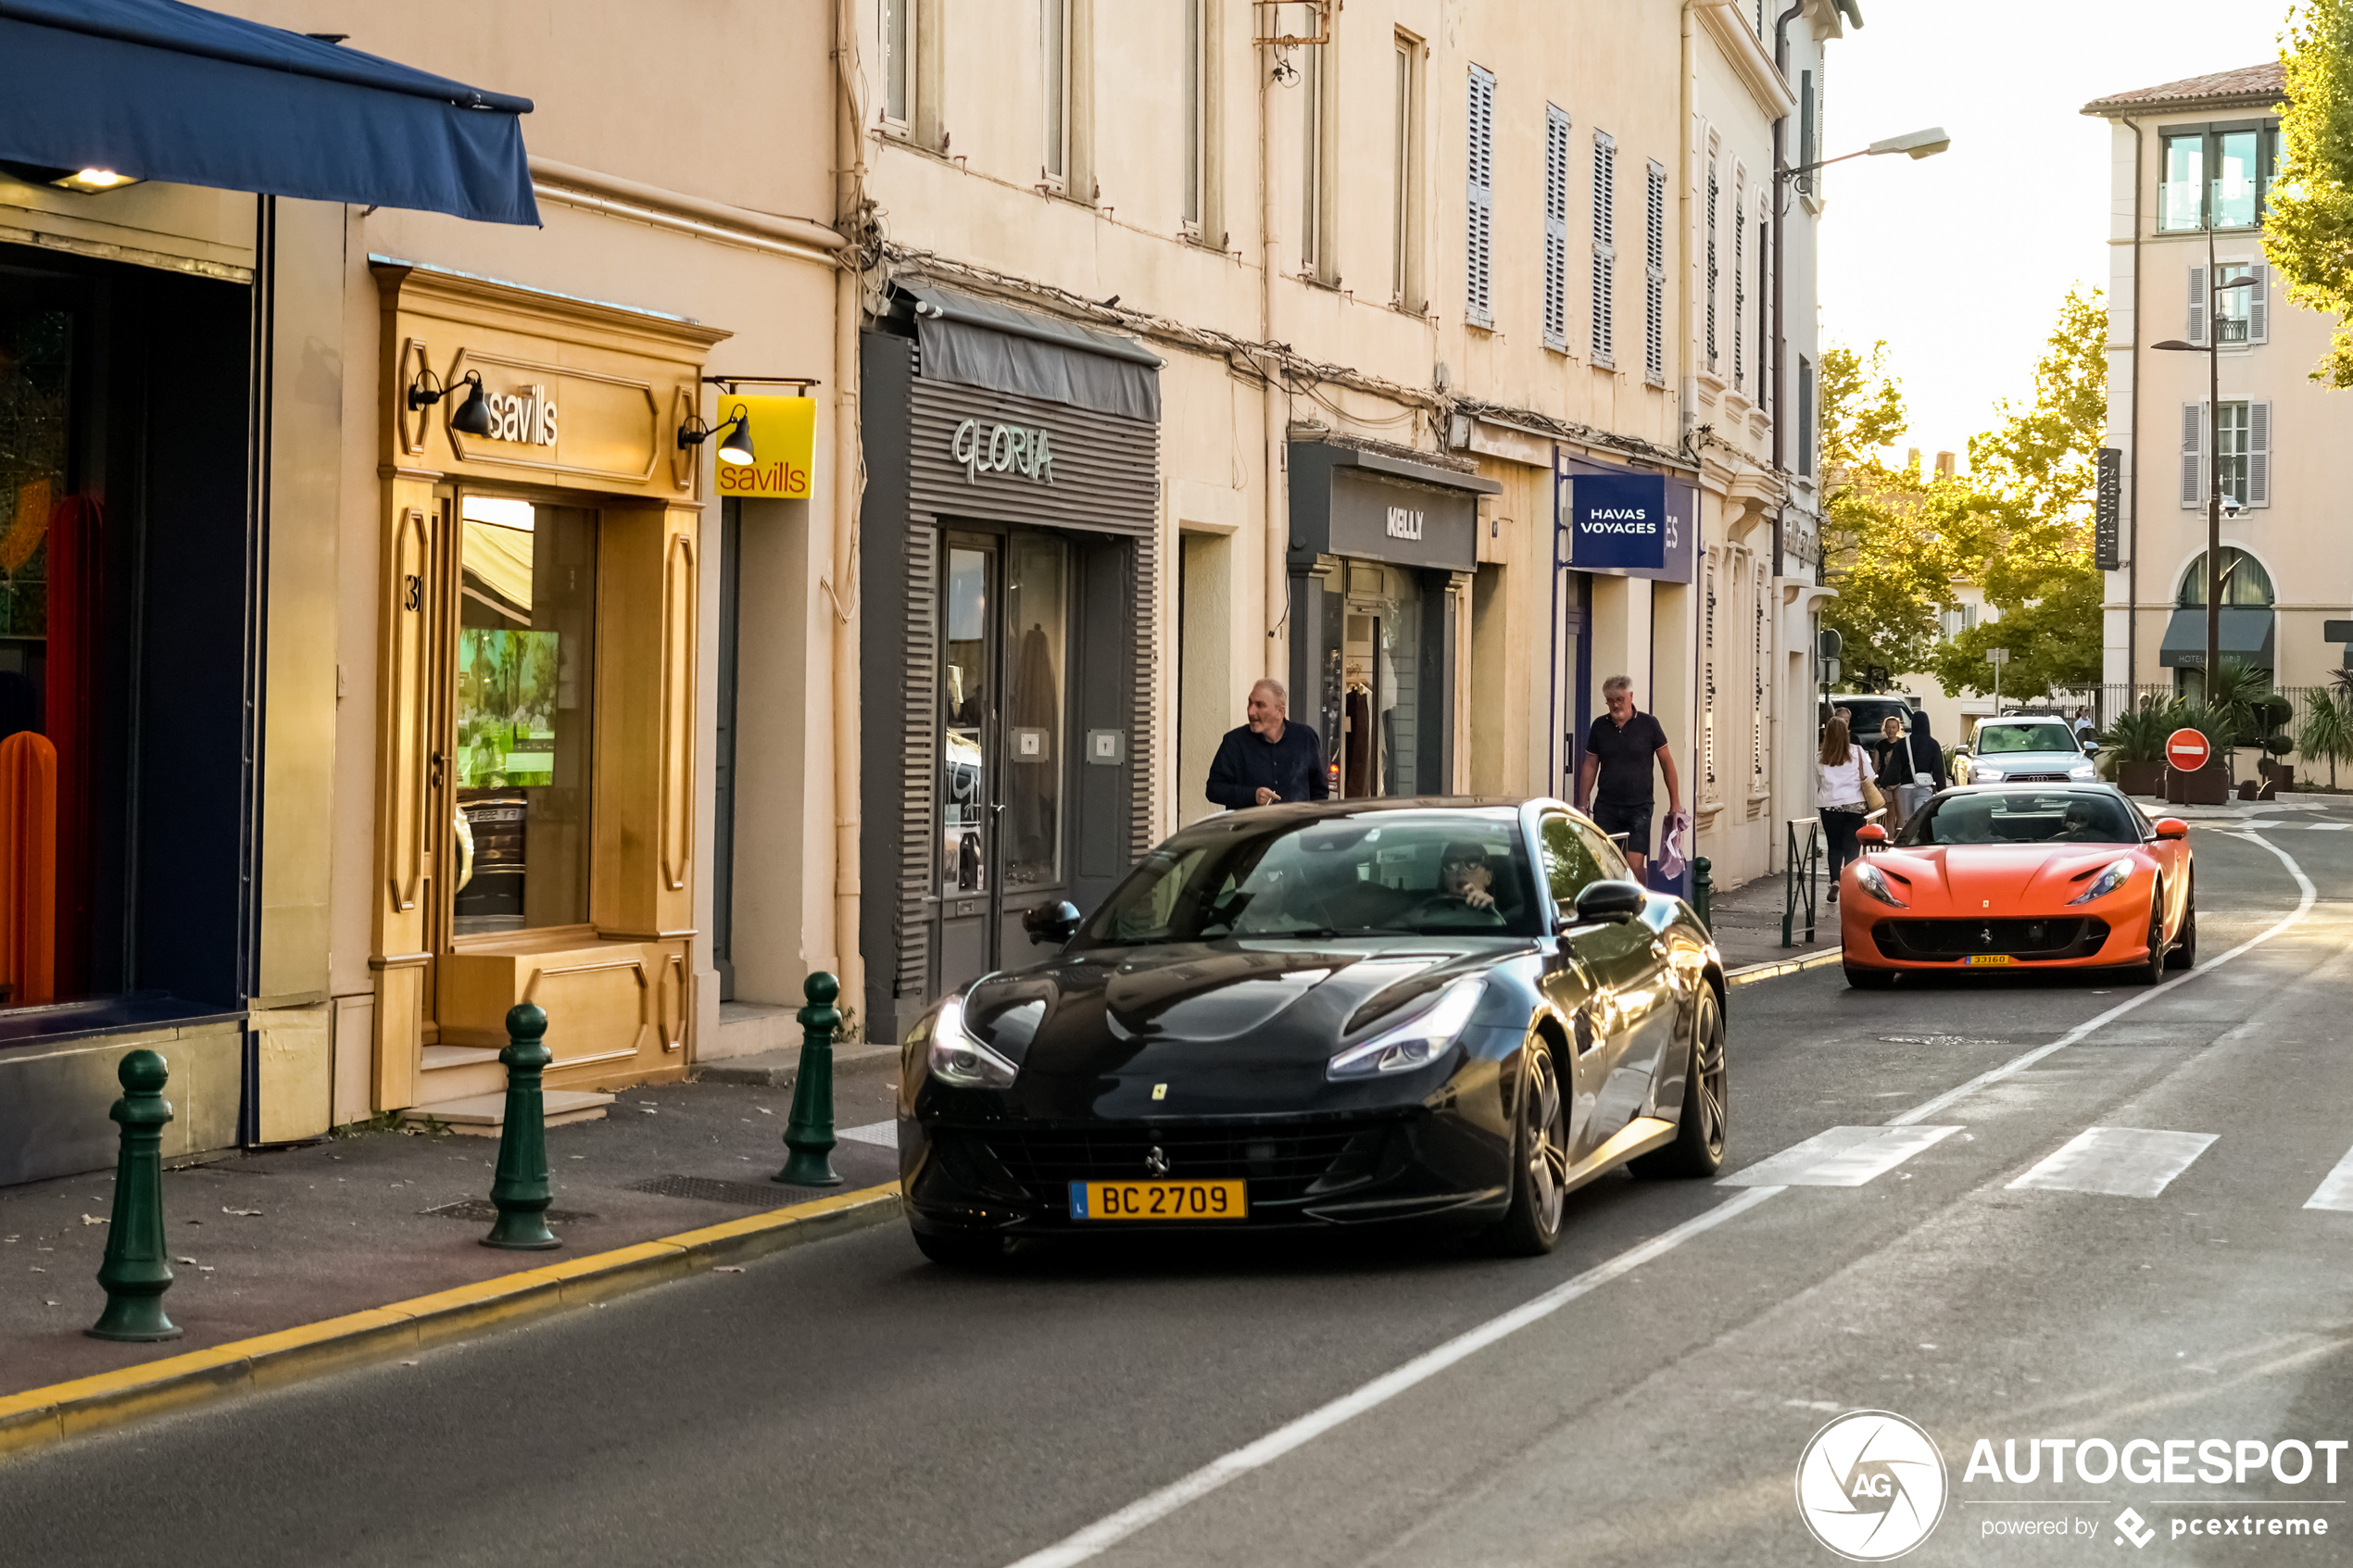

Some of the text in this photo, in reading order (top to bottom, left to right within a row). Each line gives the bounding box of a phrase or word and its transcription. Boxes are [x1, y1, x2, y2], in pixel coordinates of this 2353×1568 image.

[489, 383, 558, 447] savills
[952, 419, 1053, 485] GLORIA
[720, 461, 806, 493] savills
[1387, 507, 1424, 540] KELLY
[1580, 522, 1656, 534] VOYAGES
[1591, 508, 1646, 521] HAVAS
[405, 574, 423, 612] 31
[2178, 655, 2205, 663] HOTEL
[1076, 1186, 1227, 1214] L BC 2709
